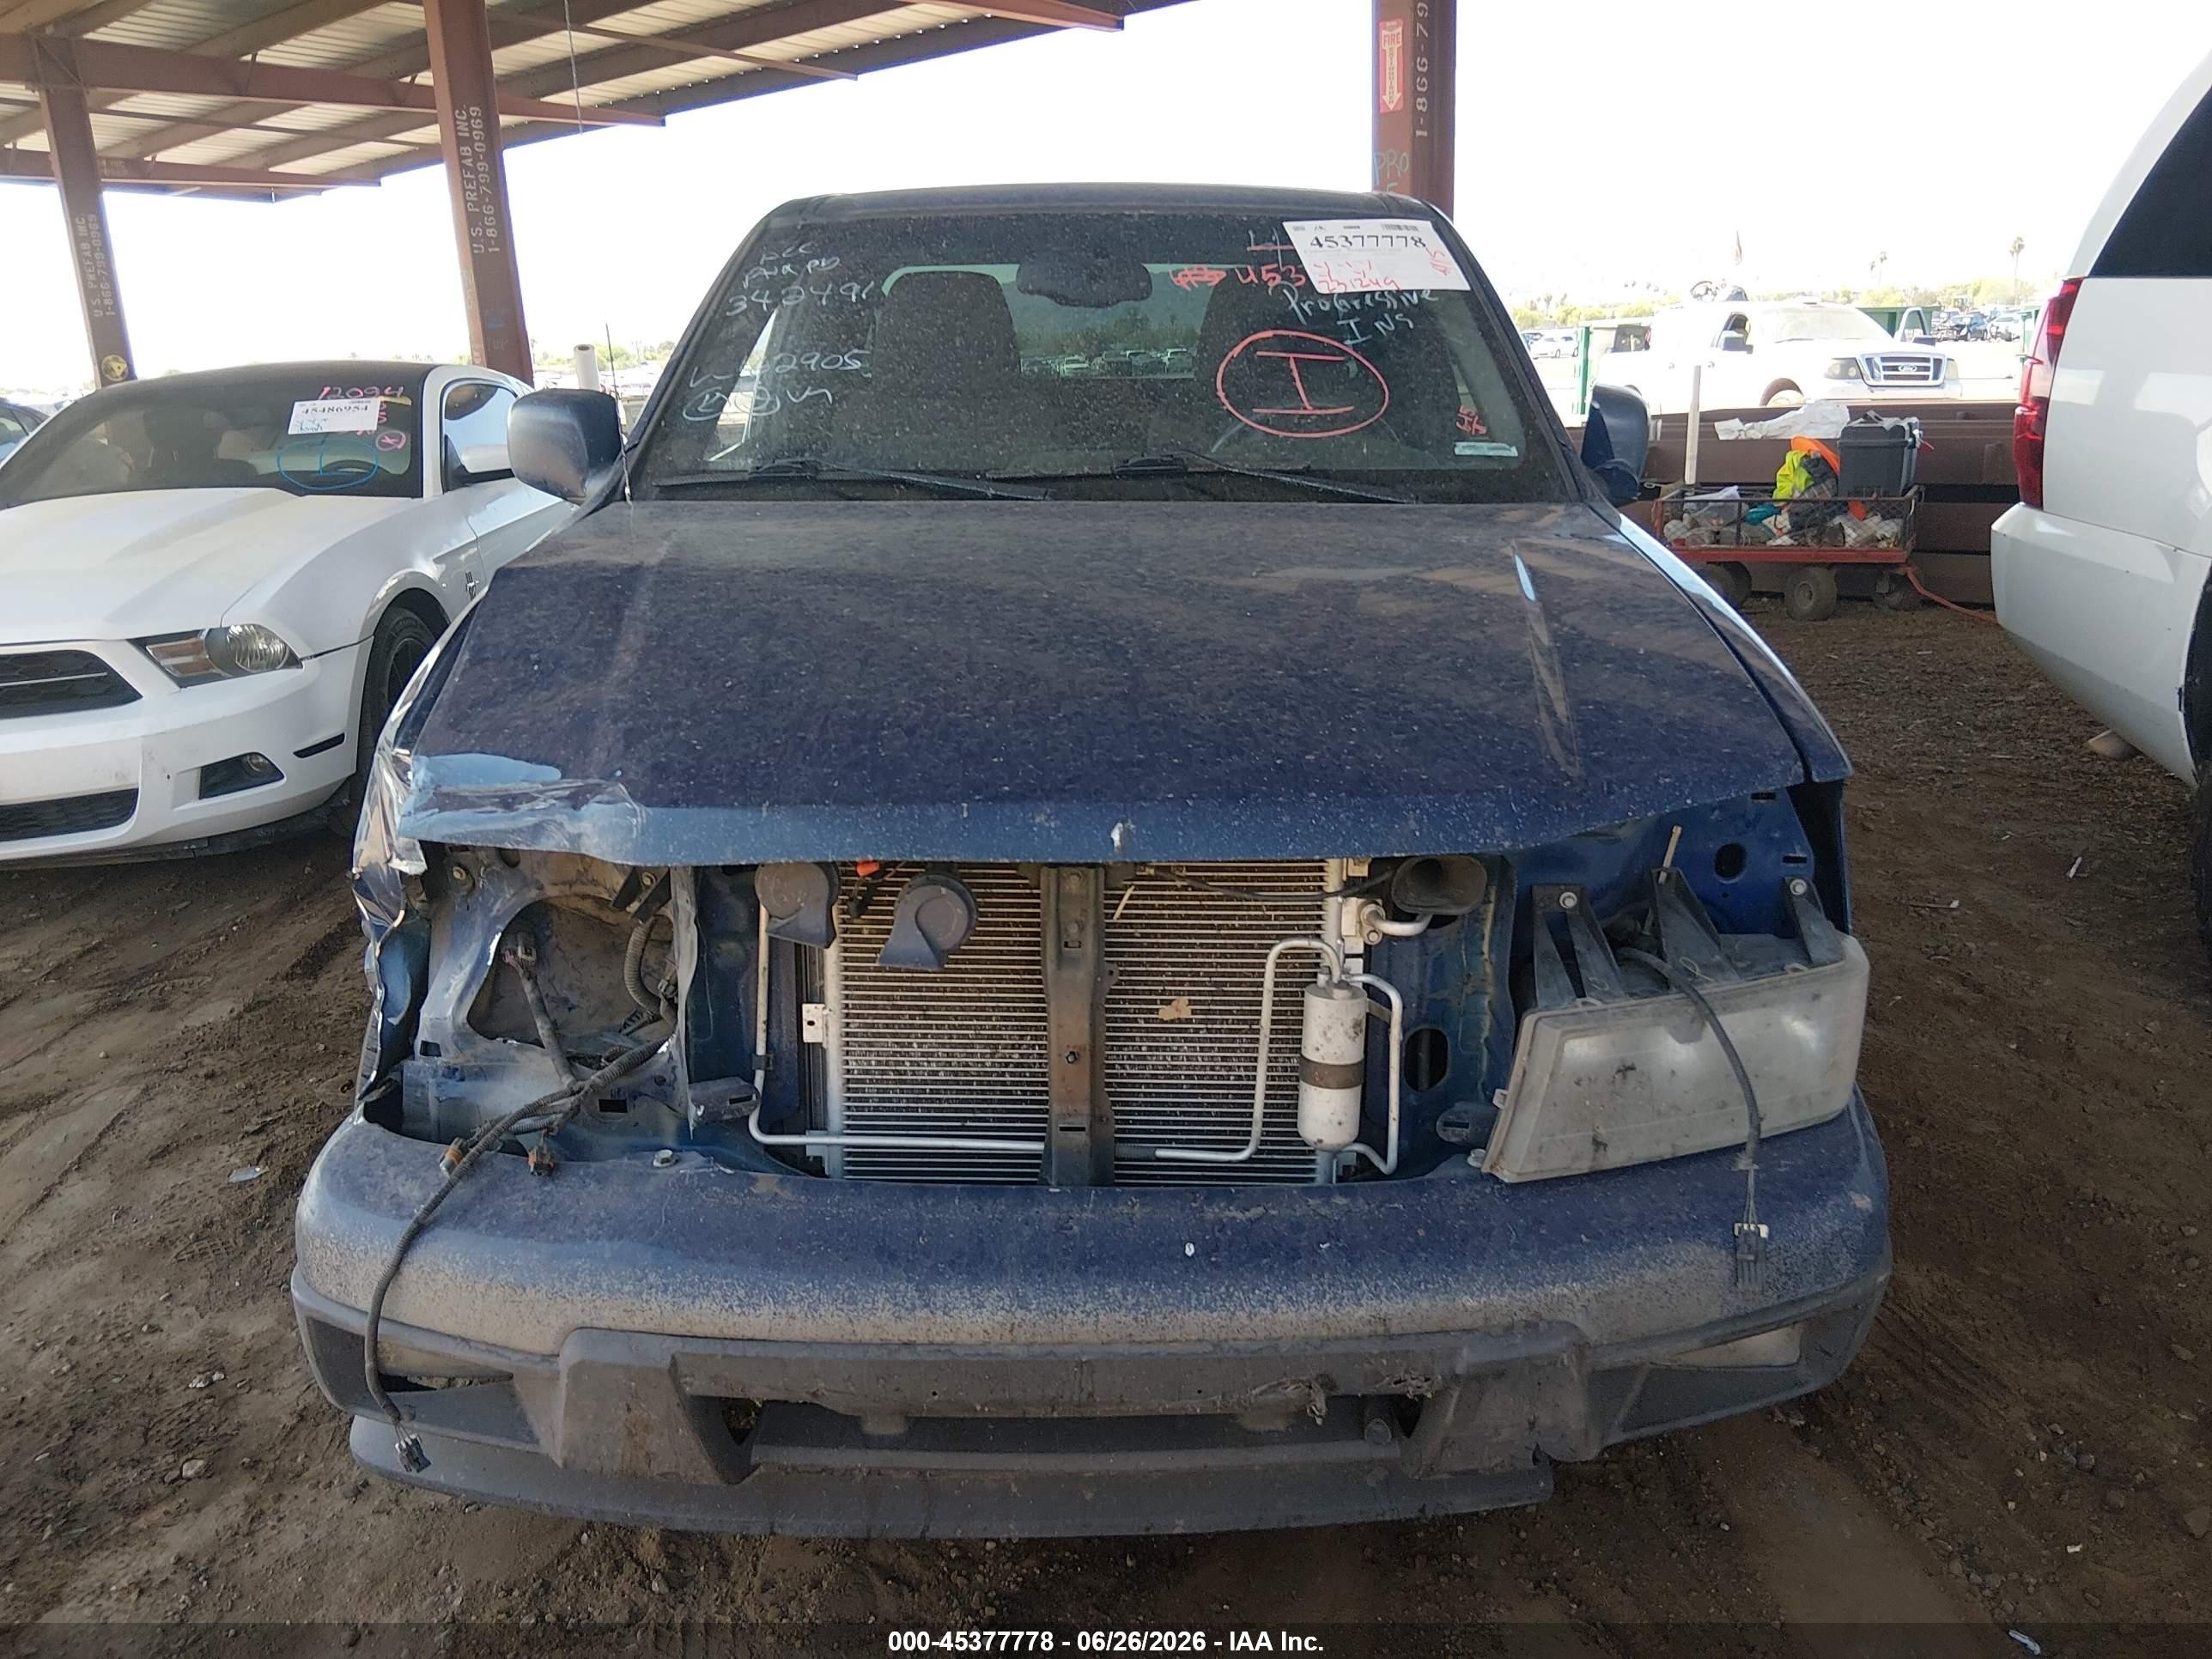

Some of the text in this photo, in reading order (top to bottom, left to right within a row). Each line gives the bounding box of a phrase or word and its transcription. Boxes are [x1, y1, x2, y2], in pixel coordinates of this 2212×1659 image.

[1382, 32, 1401, 46] FIRE
[454, 103, 471, 137] INC.
[459, 145, 480, 213] PREFAB
[469, 106, 500, 252] 1-866-799-0969
[471, 221, 484, 253] U.S.
[1310, 234, 1427, 249] 45377778
[80, 241, 98, 289] PREFAB
